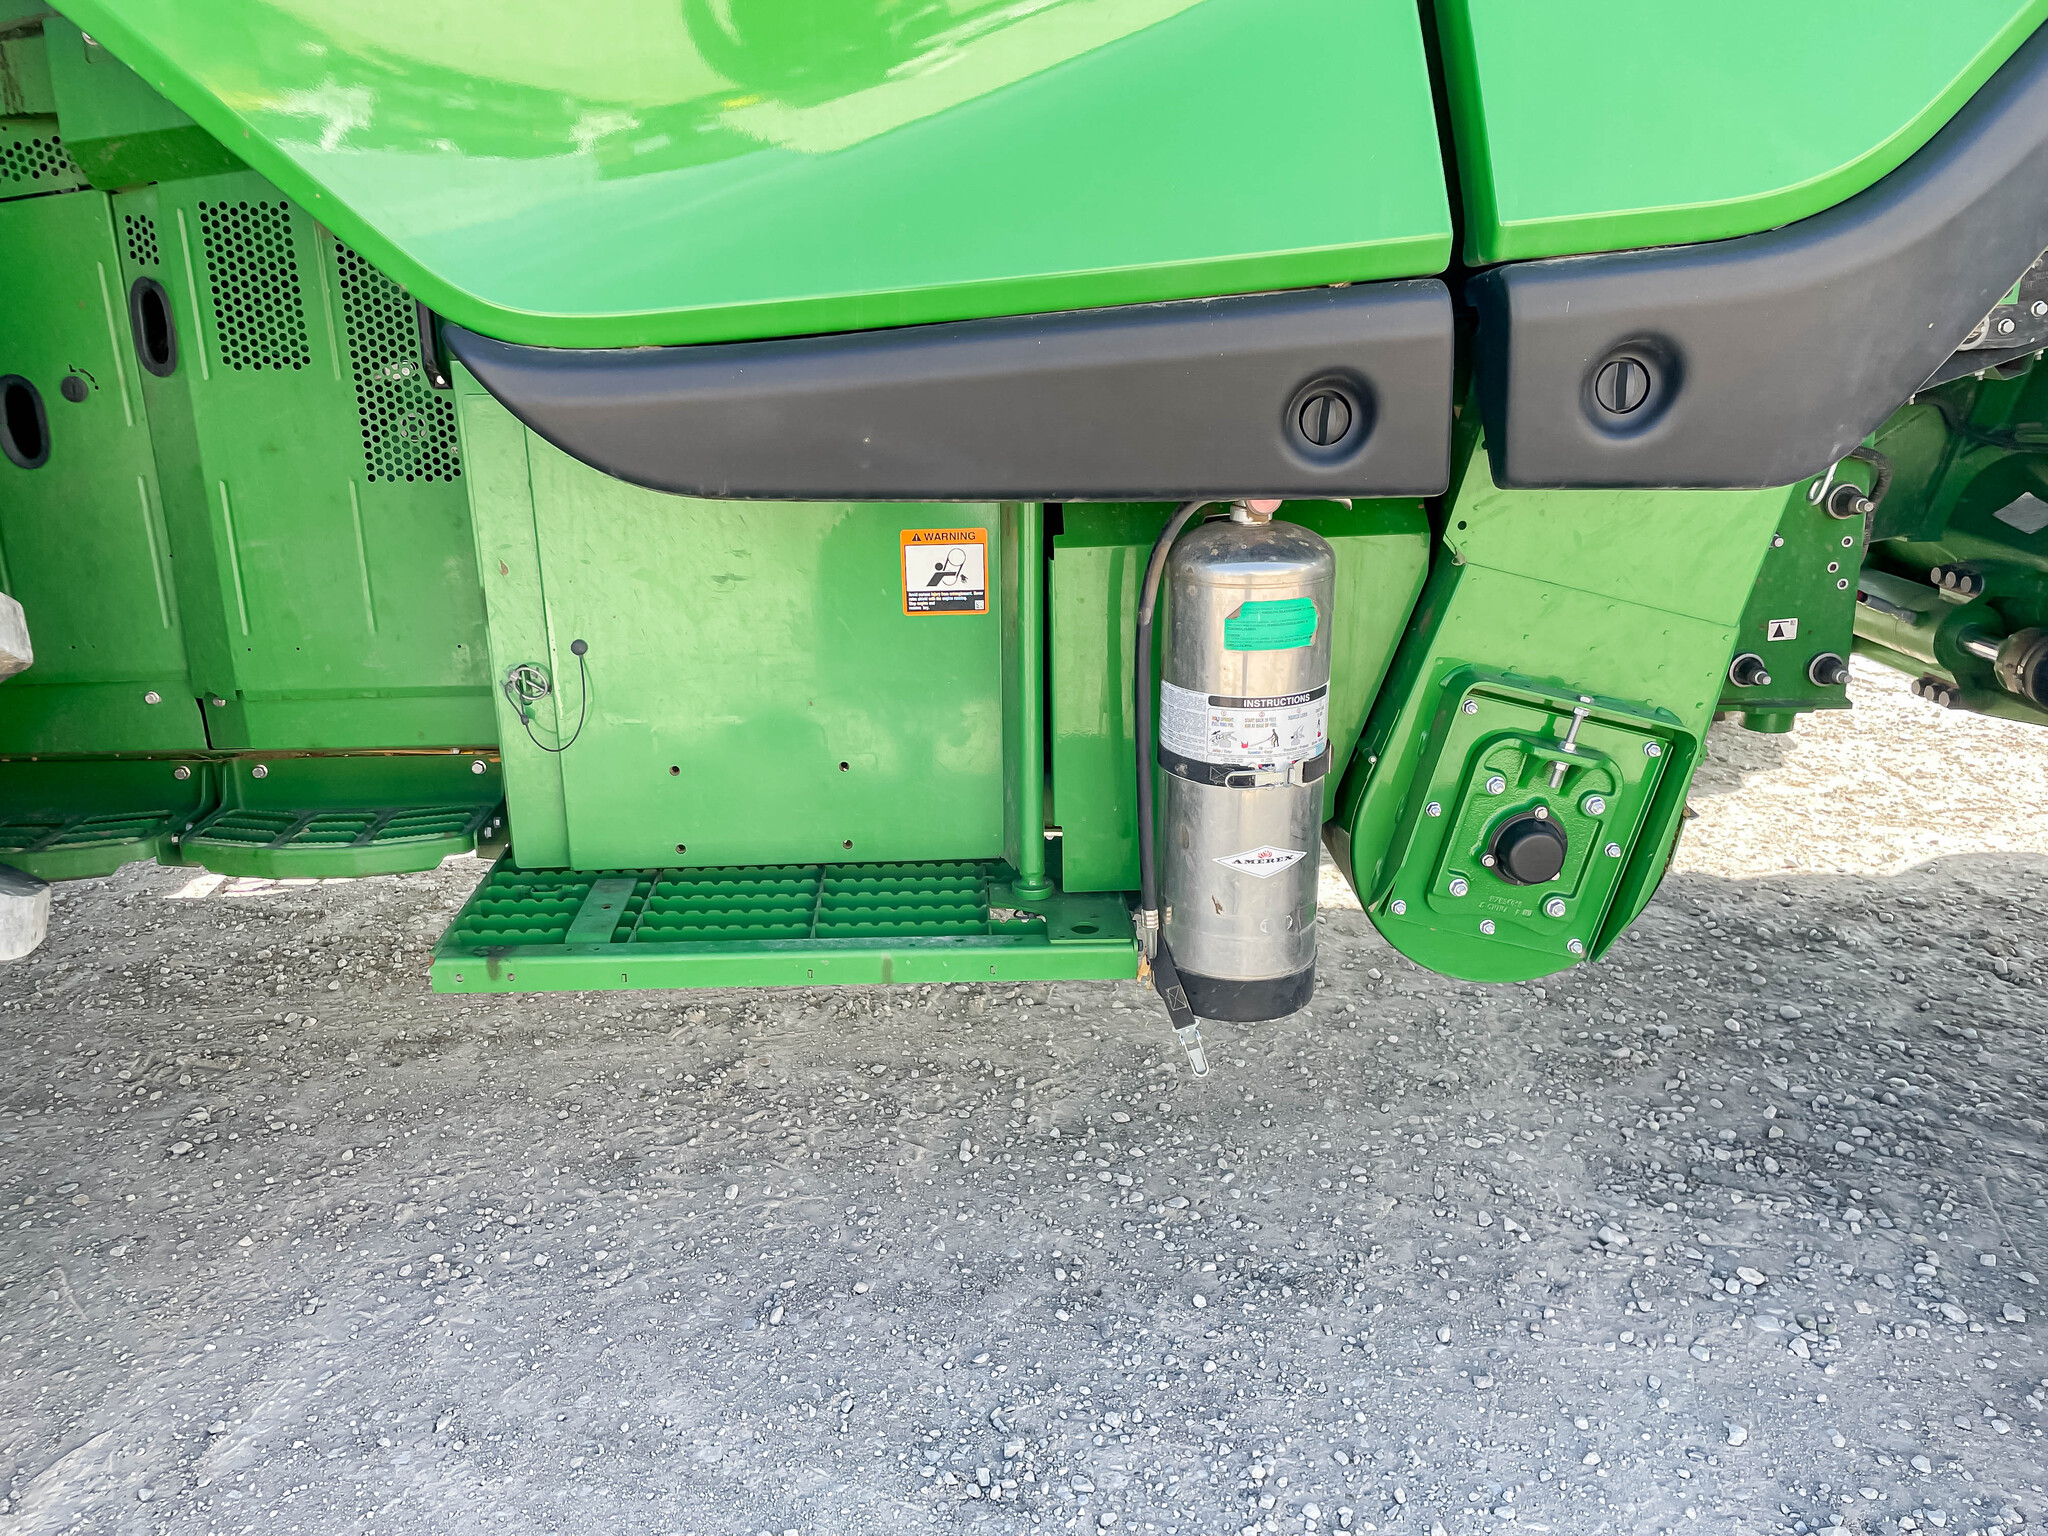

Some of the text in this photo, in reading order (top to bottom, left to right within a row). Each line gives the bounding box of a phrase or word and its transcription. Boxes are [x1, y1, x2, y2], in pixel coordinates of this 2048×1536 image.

[924, 531, 976, 541] WARNING
[1243, 694, 1311, 708] INSTRUCTIONS
[1232, 854, 1294, 864] AMEREX
